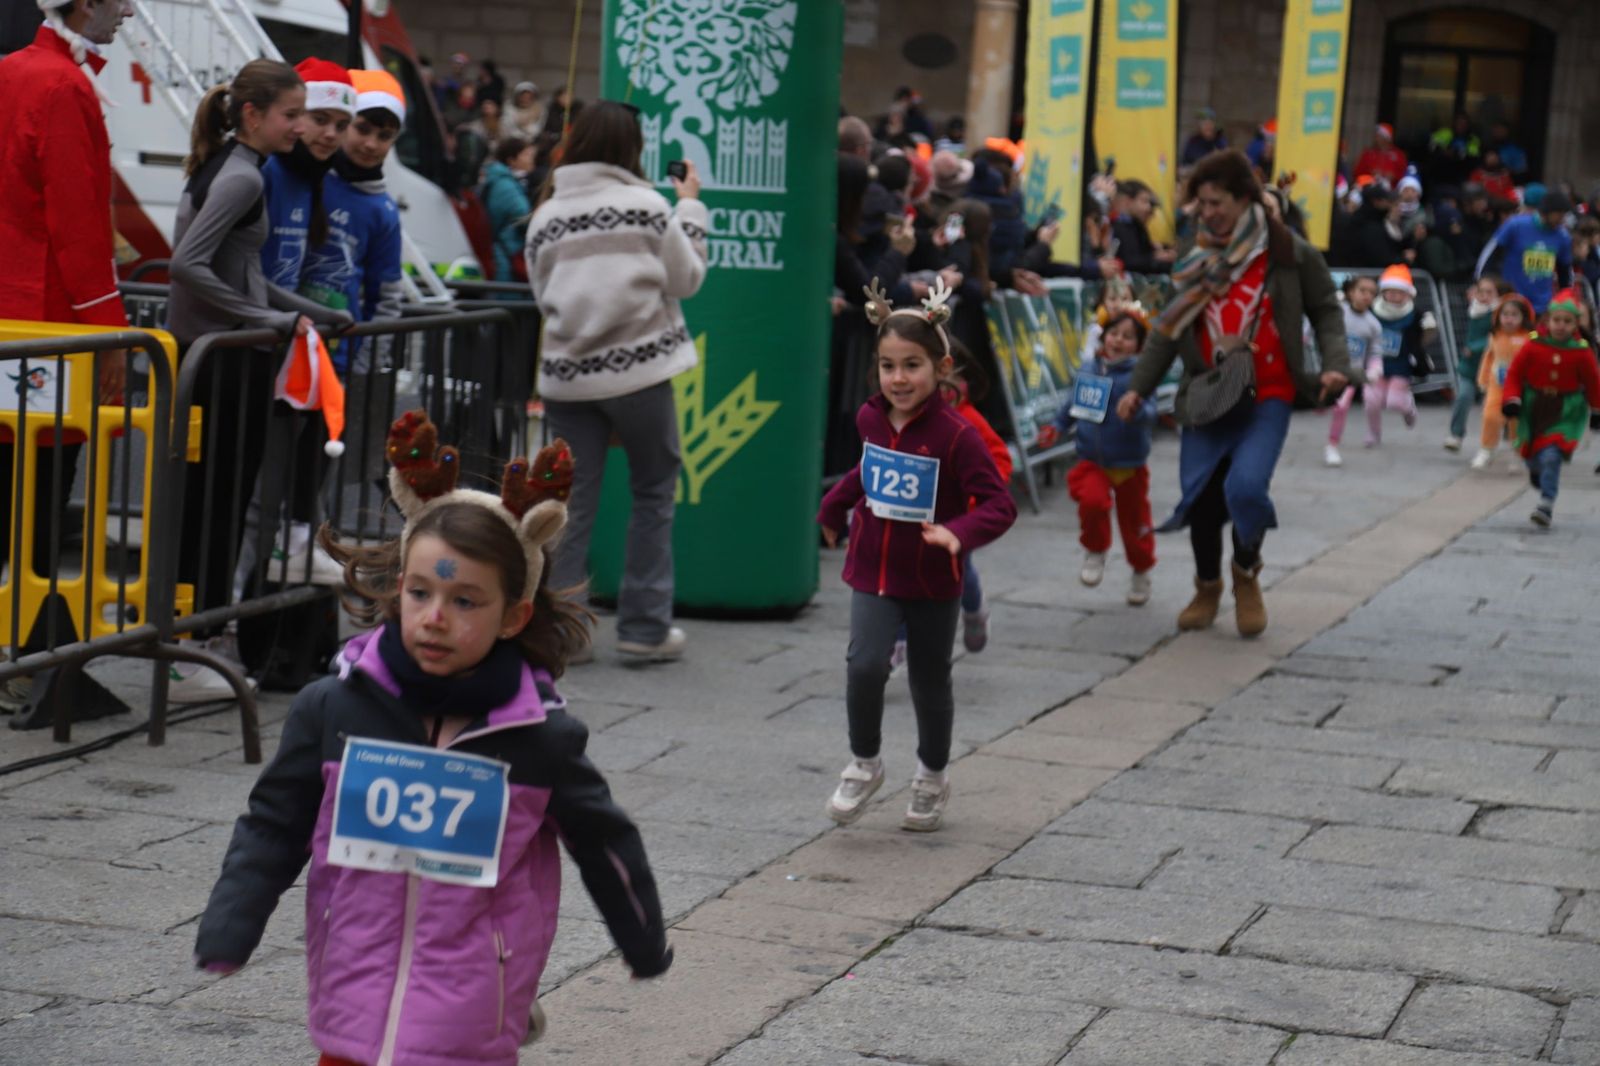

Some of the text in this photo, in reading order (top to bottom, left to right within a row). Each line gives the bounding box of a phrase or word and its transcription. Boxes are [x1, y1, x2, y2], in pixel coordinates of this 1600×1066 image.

[708, 207, 785, 239] CION
[707, 238, 784, 271] URAL
[871, 465, 920, 500] 123
[366, 777, 475, 837] 037
